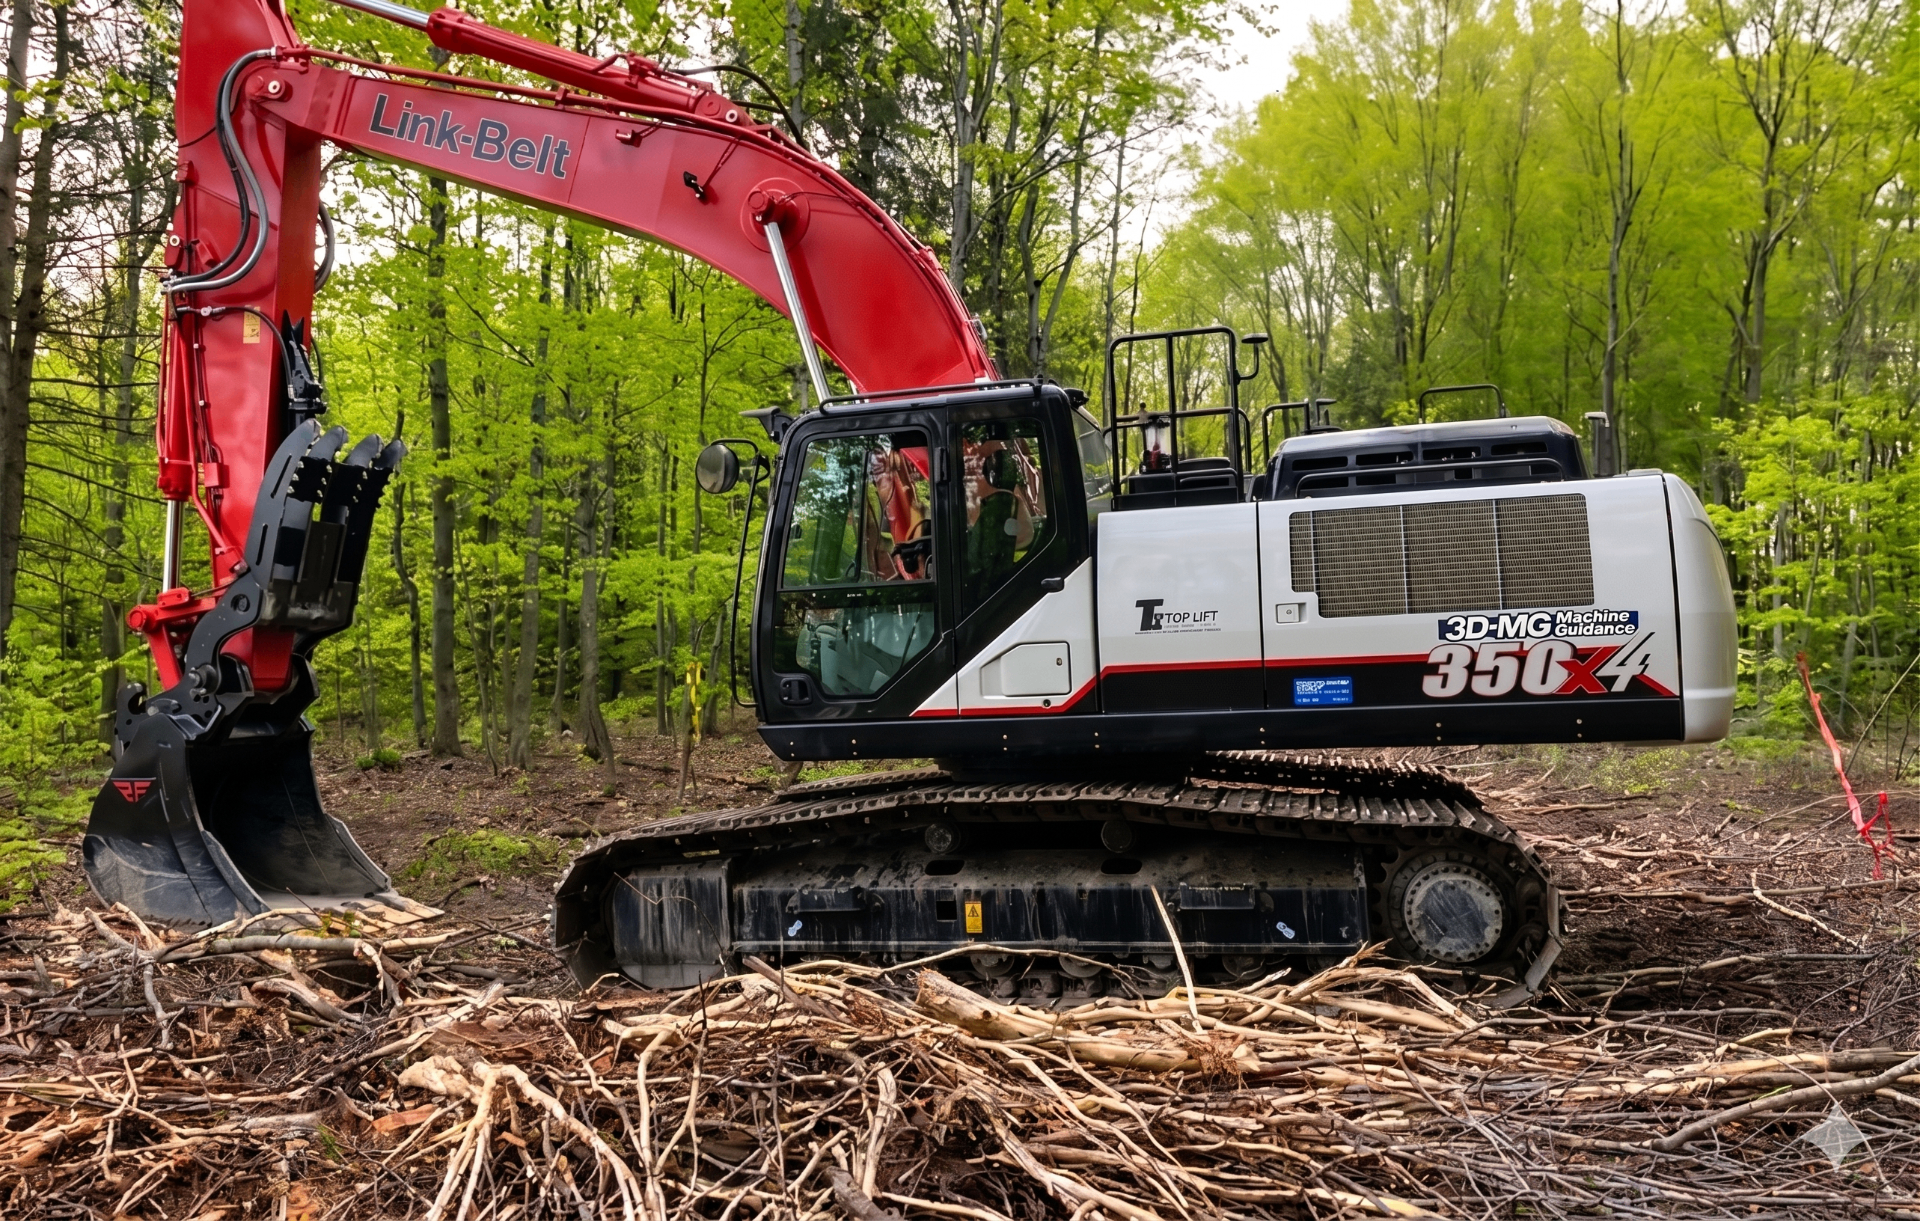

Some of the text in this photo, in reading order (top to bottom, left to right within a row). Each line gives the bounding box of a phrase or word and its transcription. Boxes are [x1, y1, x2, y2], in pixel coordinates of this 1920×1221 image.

[369, 93, 571, 179] Link-Belt
[1165, 610, 1218, 624] TOP LIFT
[1445, 608, 1630, 641] 3D-MG Machine
[1554, 622, 1636, 637] Guidance
